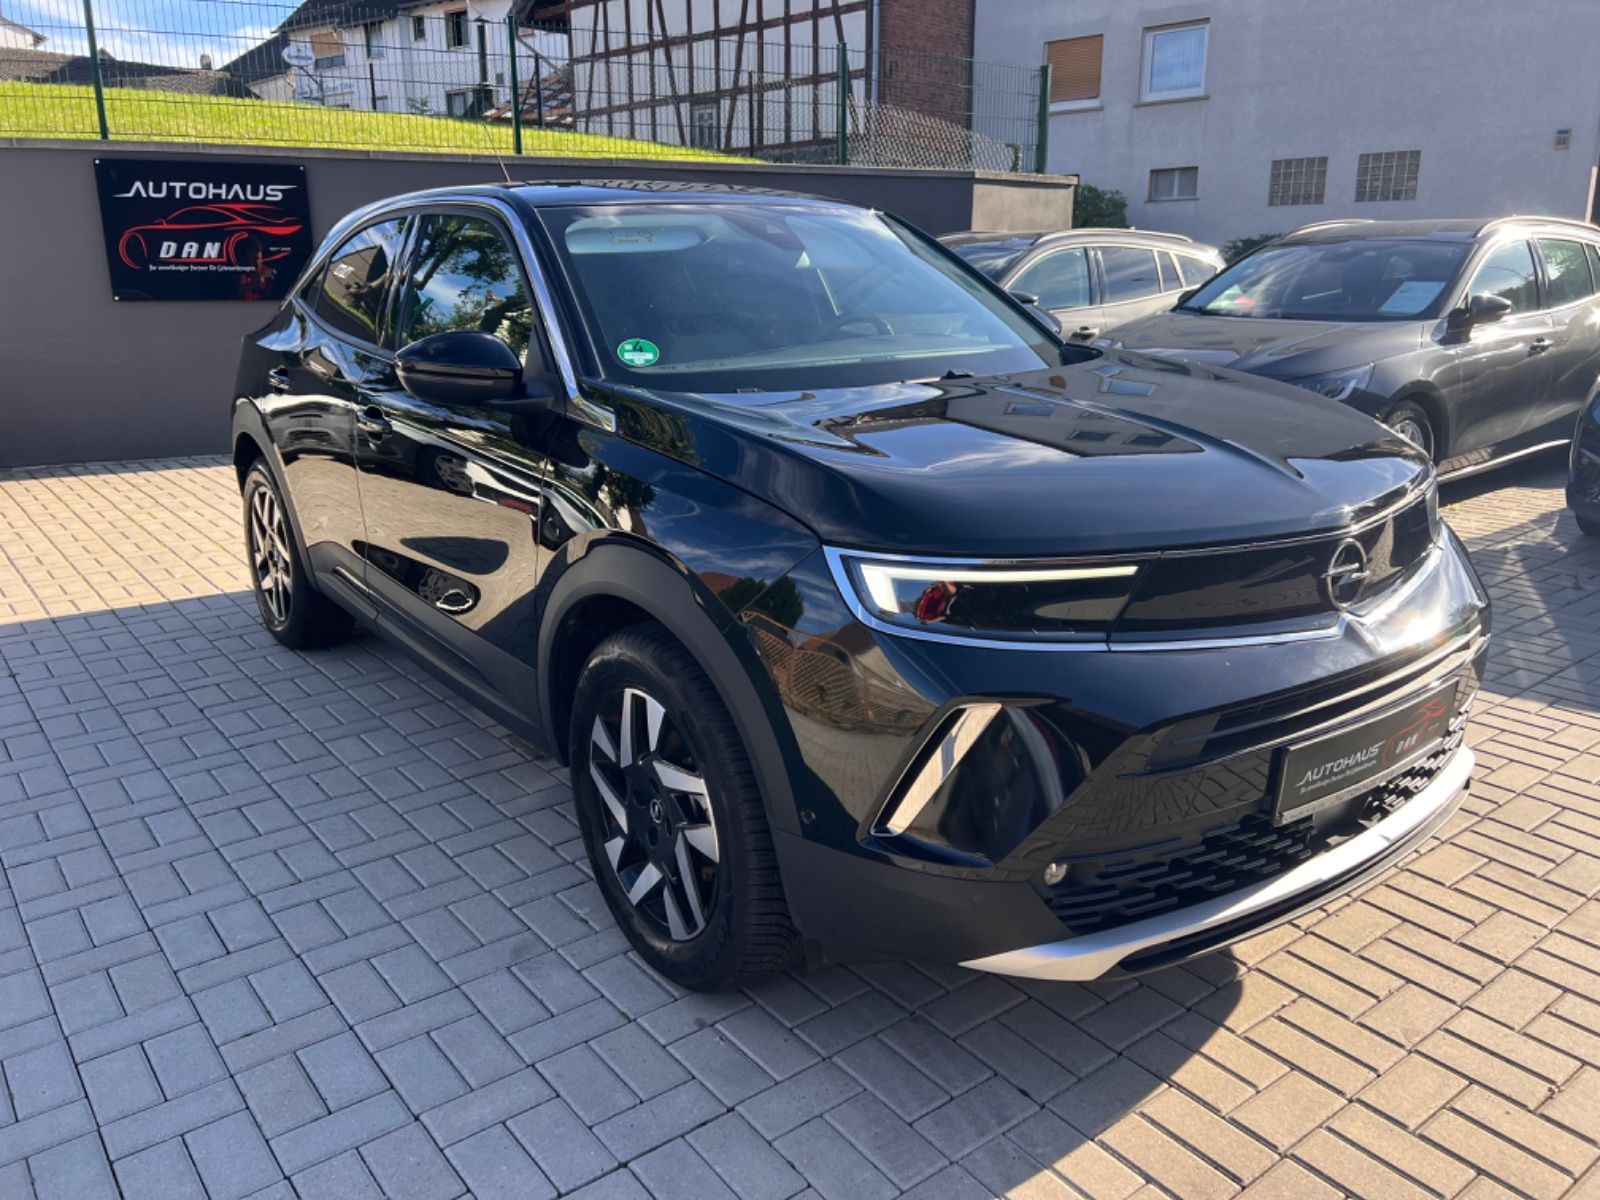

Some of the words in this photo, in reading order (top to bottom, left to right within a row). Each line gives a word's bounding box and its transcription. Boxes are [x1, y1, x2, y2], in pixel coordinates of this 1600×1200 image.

[113, 181, 297, 201] AUTOHAUS
[159, 241, 221, 258] DAN
[633, 341, 644, 353] 4
[1294, 740, 1386, 787] AUTOHAUS
